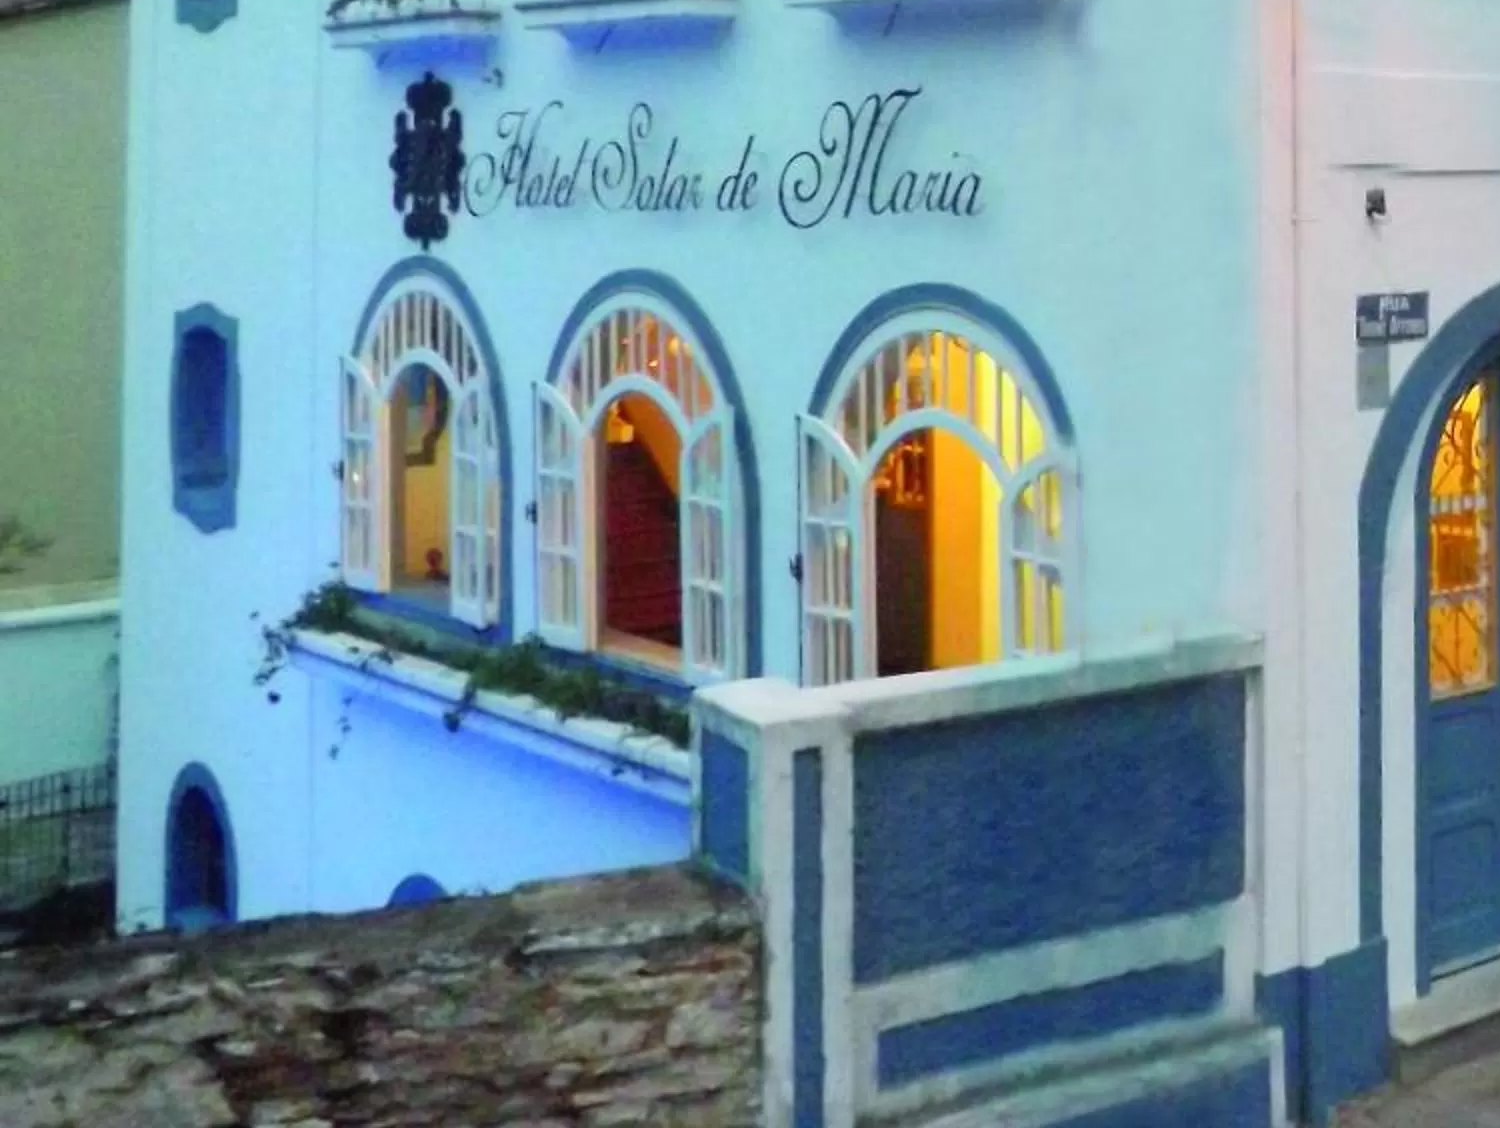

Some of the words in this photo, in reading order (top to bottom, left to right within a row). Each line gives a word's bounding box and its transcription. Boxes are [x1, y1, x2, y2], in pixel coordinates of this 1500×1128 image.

[464, 100, 589, 217] Hotel
[591, 102, 704, 213] Solar
[716, 134, 757, 212] de
[777, 86, 984, 229] Maria
